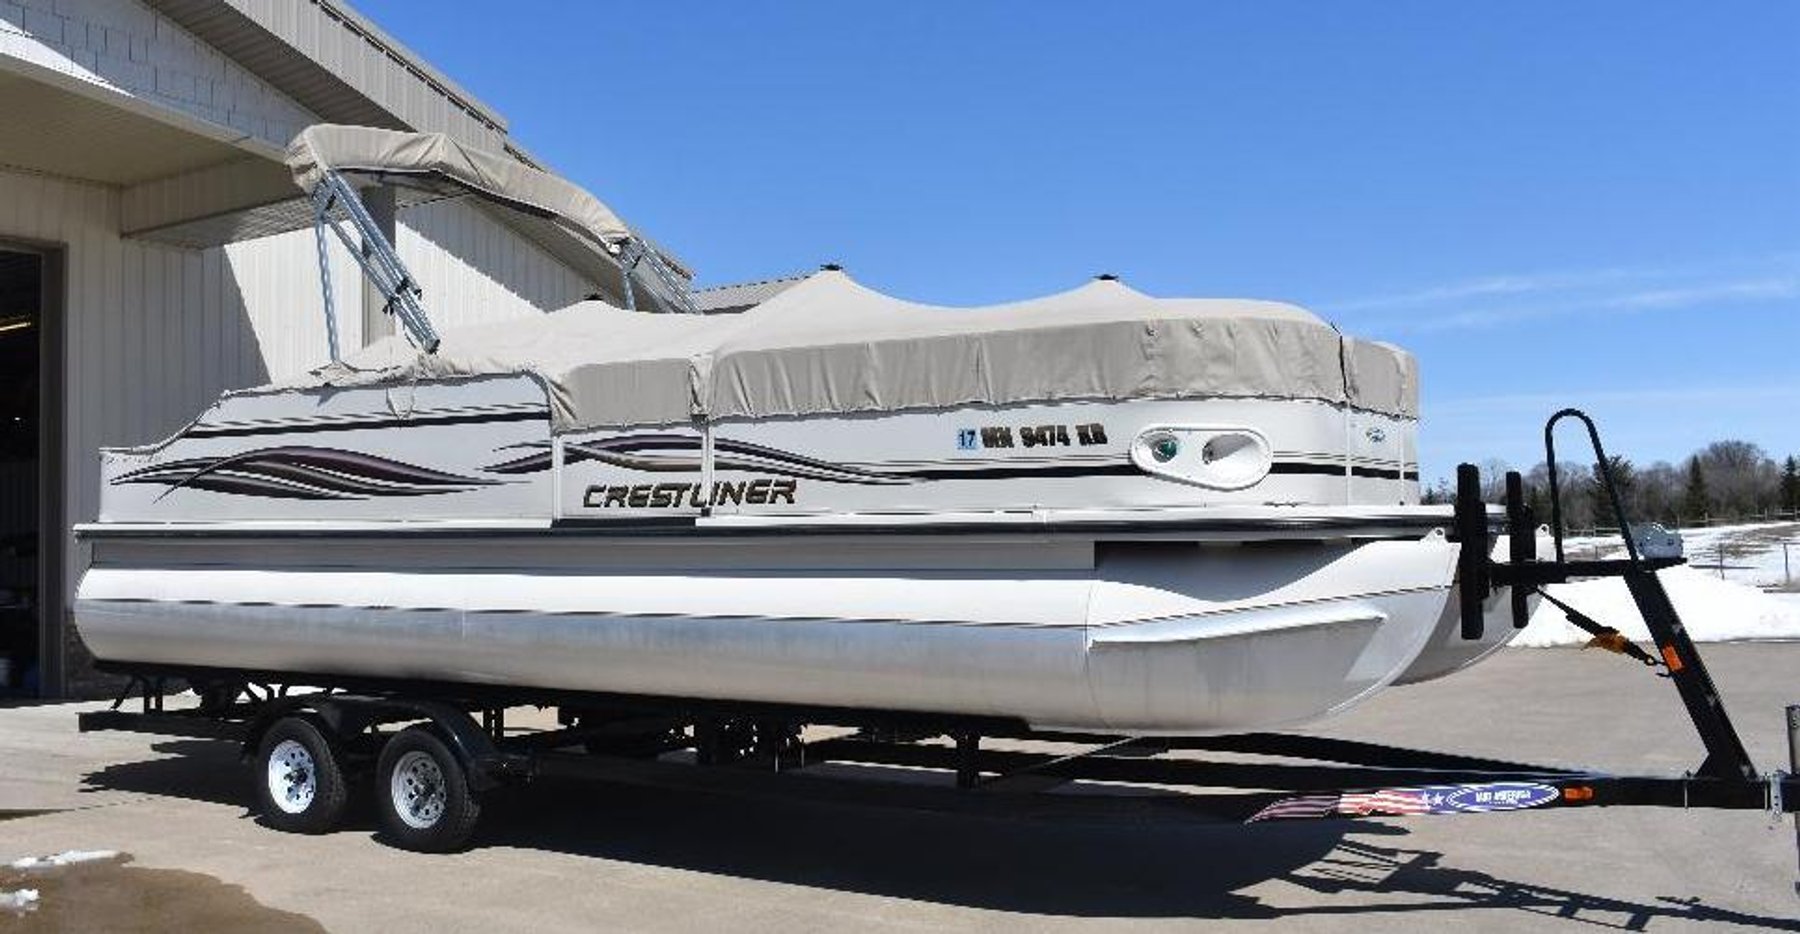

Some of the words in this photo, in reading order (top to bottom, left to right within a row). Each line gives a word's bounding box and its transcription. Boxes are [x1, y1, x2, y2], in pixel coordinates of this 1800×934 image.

[957, 430, 976, 446] 17
[1019, 425, 1071, 447] 9474
[583, 479, 797, 508] CRESTLINER
